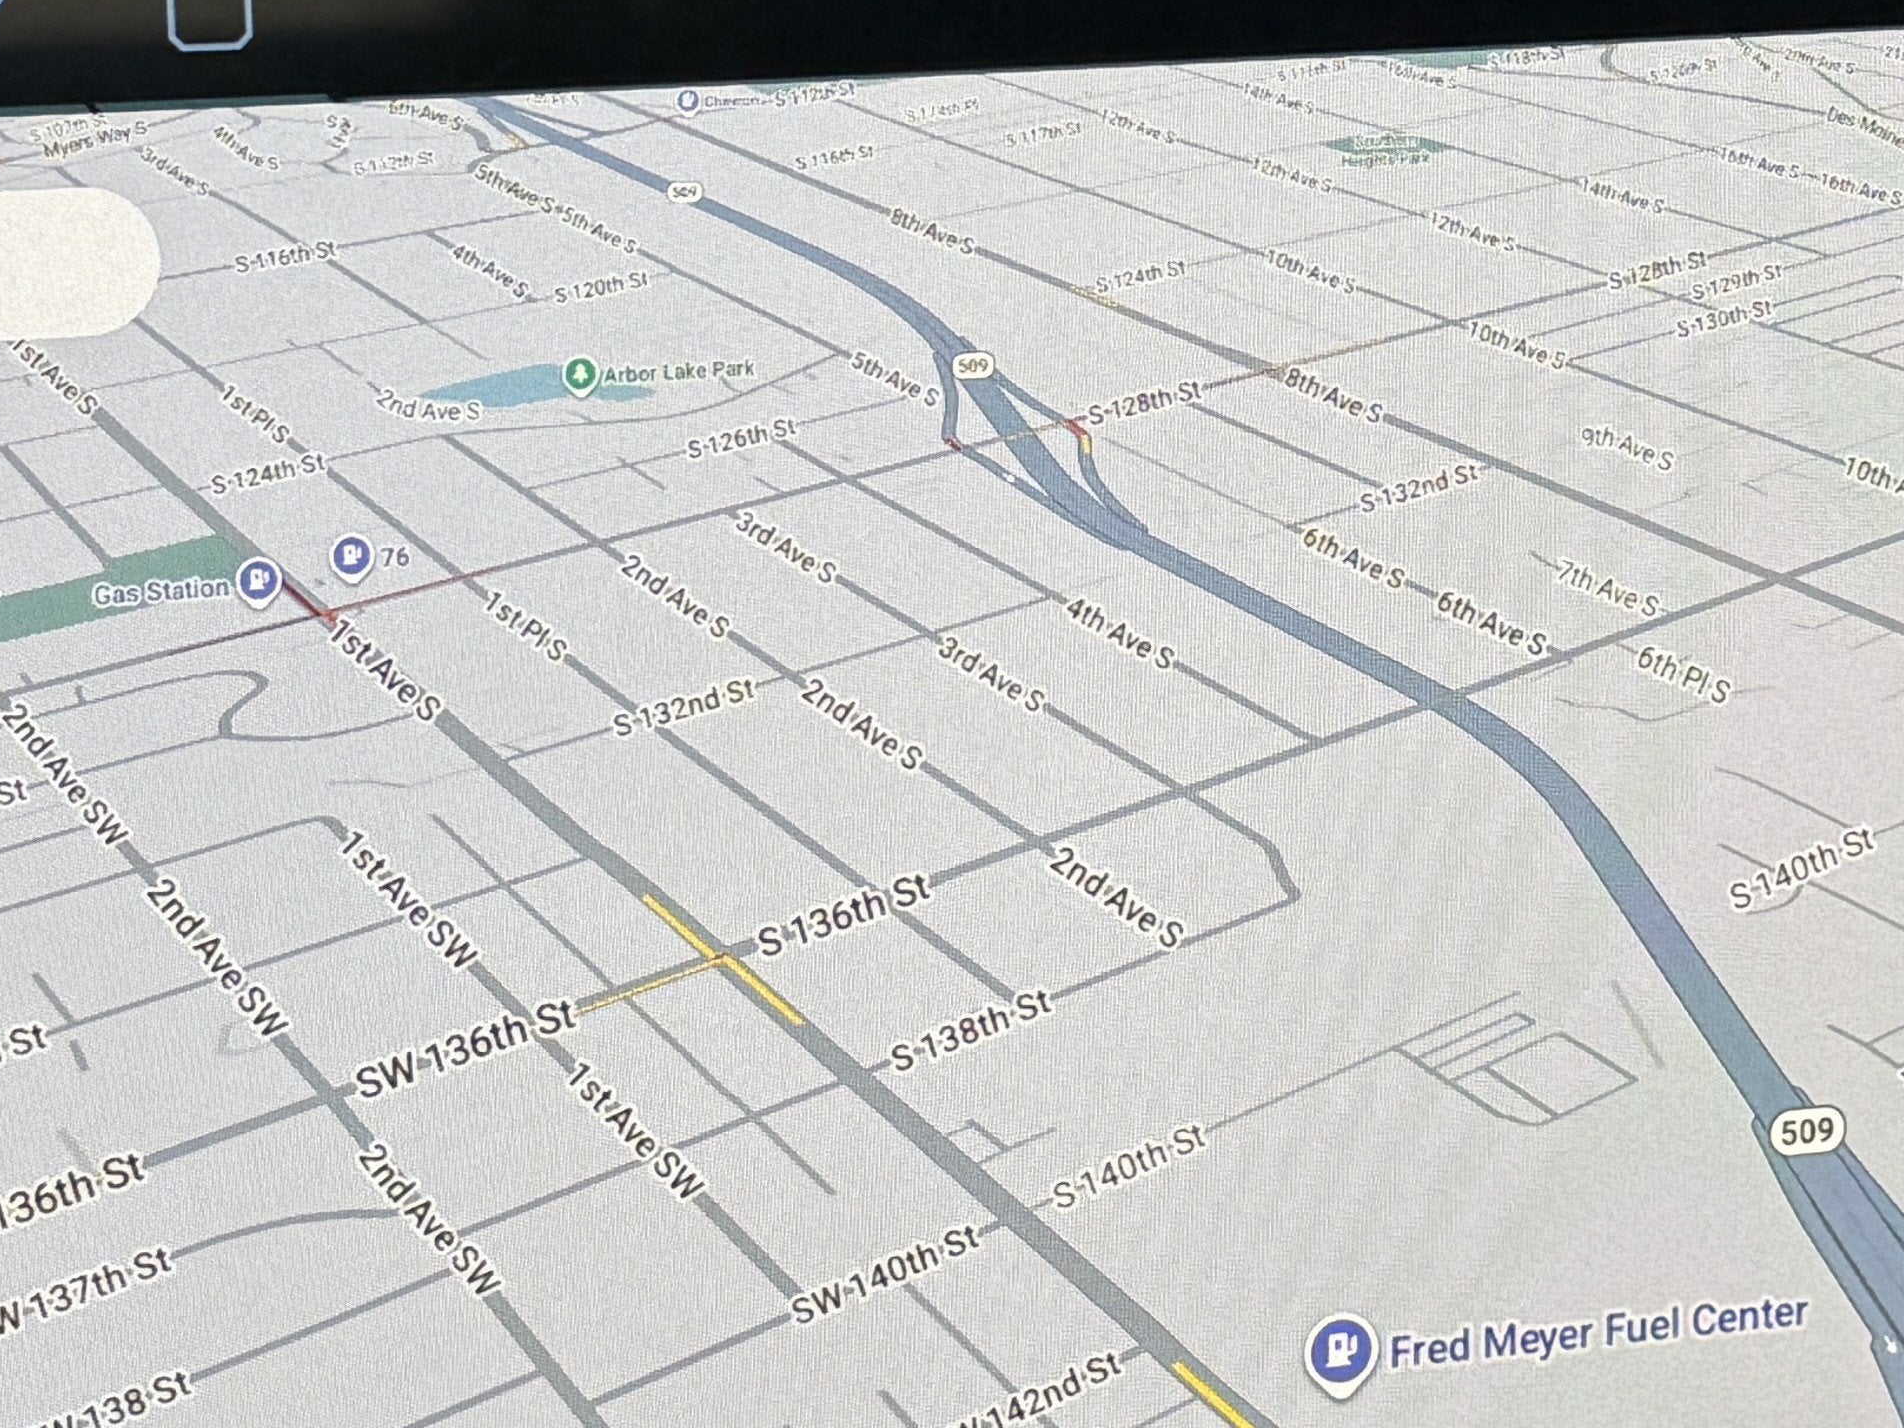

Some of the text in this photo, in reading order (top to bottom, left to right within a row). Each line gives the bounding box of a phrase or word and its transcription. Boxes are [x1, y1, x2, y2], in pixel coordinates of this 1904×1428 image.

[605, 359, 753, 383] Arbor Lake Park
[1089, 381, 1201, 425] S 128th St
[381, 547, 410, 567] 76
[95, 578, 229, 605] Gas Station
[613, 679, 754, 737] S 132nd St
[342, 831, 478, 968] 1st Ave SW
[1049, 847, 1184, 948] 2nd Ave S
[1730, 829, 1874, 909] S 140th St
[758, 874, 930, 956] S 136th St
[147, 879, 289, 1036] 2nd Ave SW
[9, 1025, 46, 1055] St
[356, 1001, 575, 1098] SW 136th St
[891, 990, 1051, 1071] S 138th St
[1781, 1118, 1833, 1145] 509
[103, 1154, 144, 1189] St
[29, 1265, 127, 1318] 137th
[133, 1248, 171, 1280] St
[792, 1226, 979, 1324] SW 140th St
[1392, 1300, 1808, 1368] Fred Meyer Fuel Center
[153, 1372, 190, 1404] St
[1086, 1353, 1121, 1384] St
